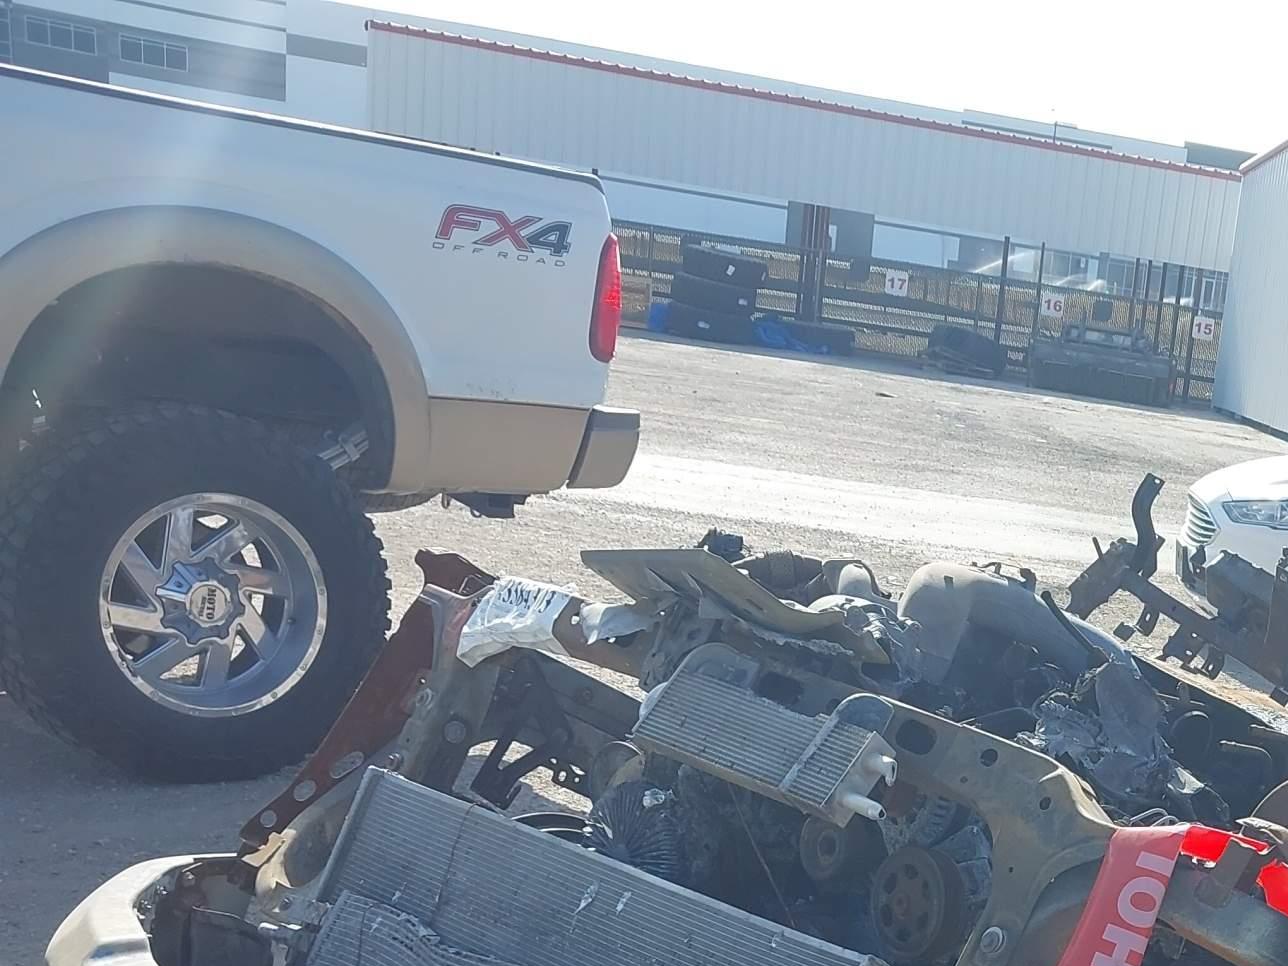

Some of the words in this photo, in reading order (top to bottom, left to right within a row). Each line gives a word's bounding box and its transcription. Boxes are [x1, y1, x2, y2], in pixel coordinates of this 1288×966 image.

[434, 203, 573, 257] FX4
[432, 241, 484, 254] OFF
[497, 251, 566, 267] ROAD
[887, 277, 907, 290] 17
[1044, 298, 1063, 312] 16
[1195, 322, 1213, 335] 15
[206, 587, 217, 620] MOTO
